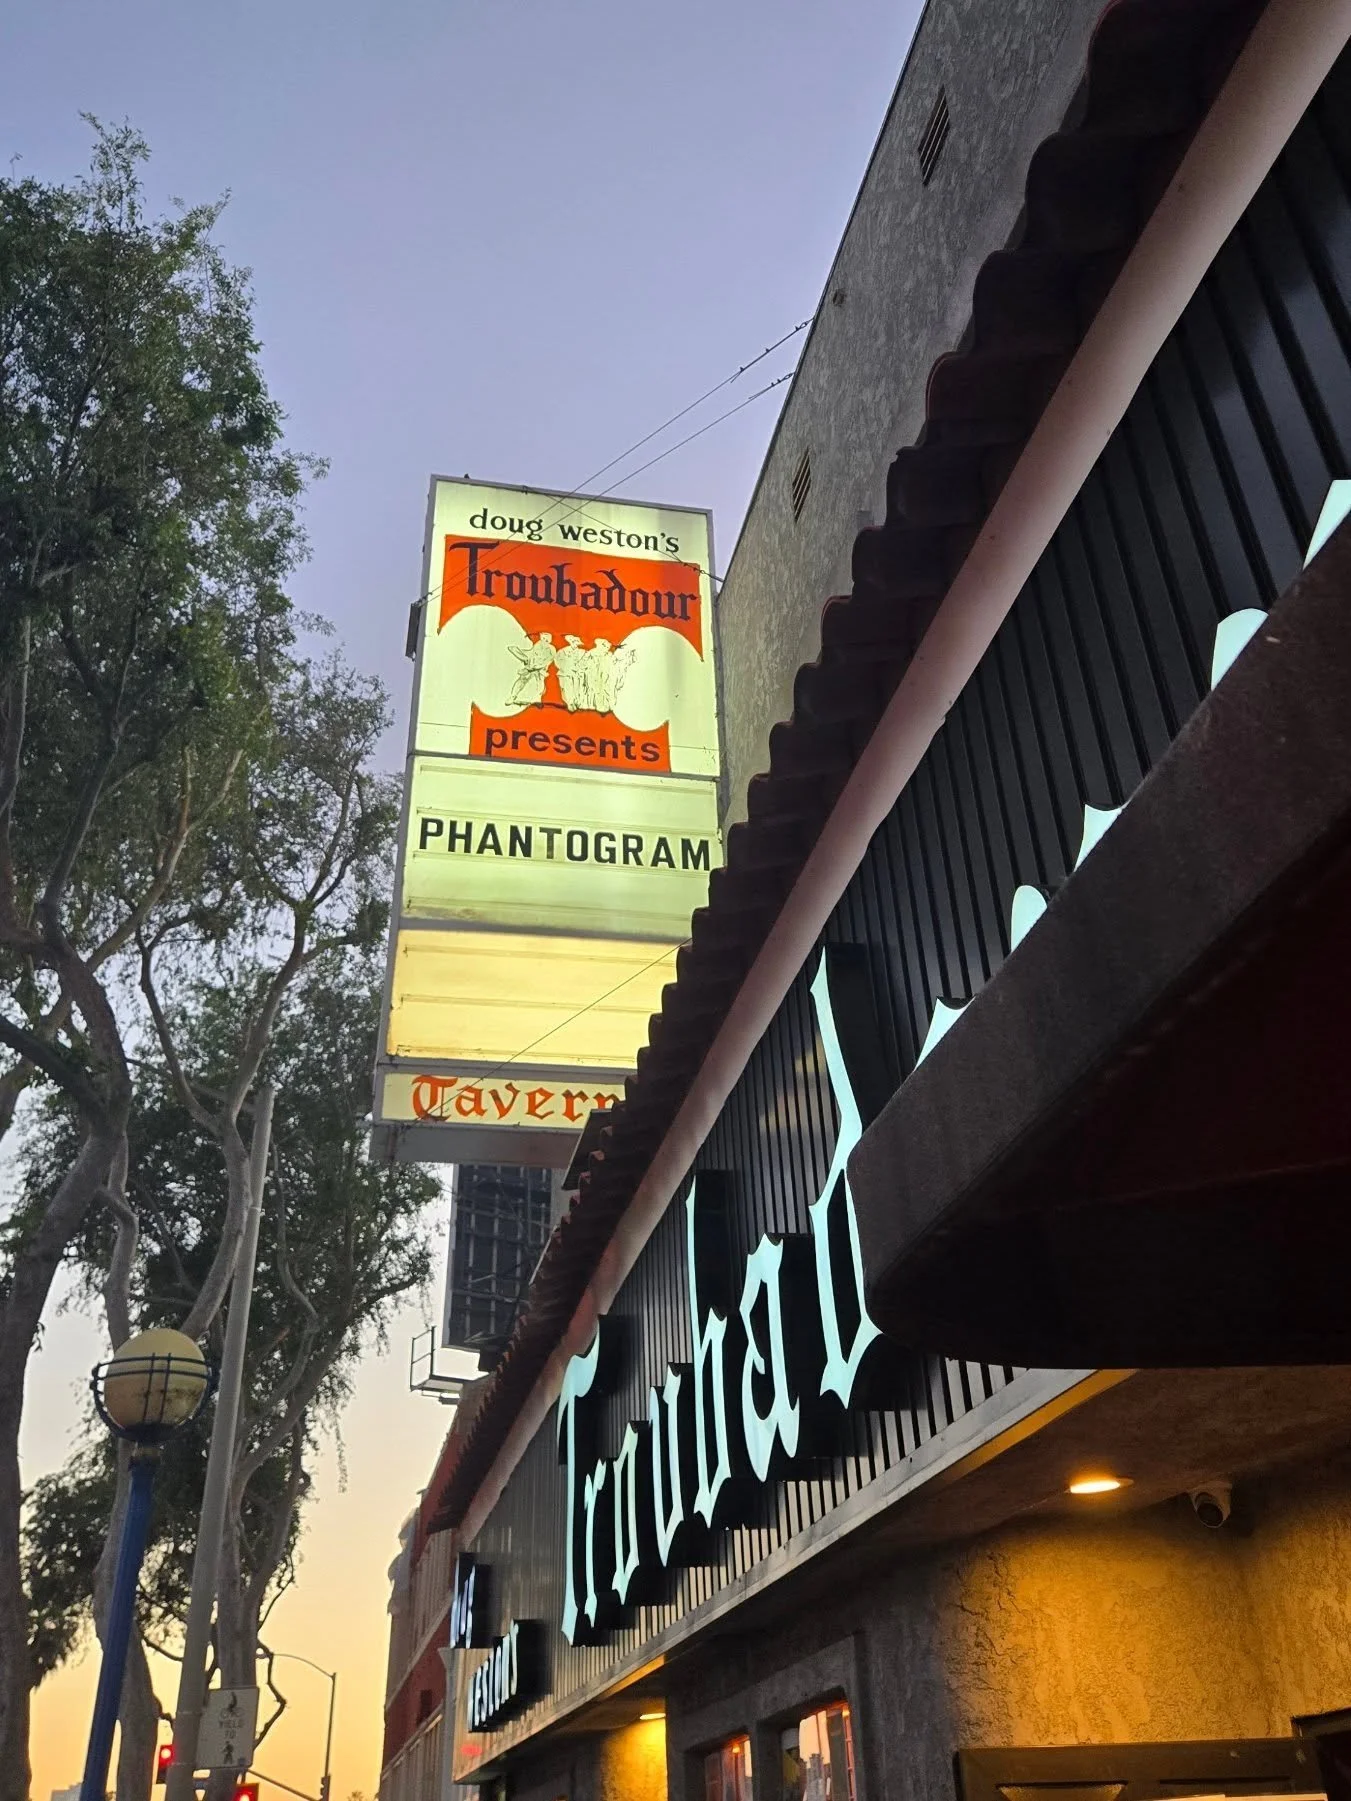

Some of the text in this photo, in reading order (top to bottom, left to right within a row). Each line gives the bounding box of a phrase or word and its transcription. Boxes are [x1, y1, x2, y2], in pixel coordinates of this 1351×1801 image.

[469, 508, 680, 553] doug weston's
[449, 541, 698, 621] Troubadour
[485, 727, 660, 762] presents
[418, 817, 711, 871] PHANTOGRAM
